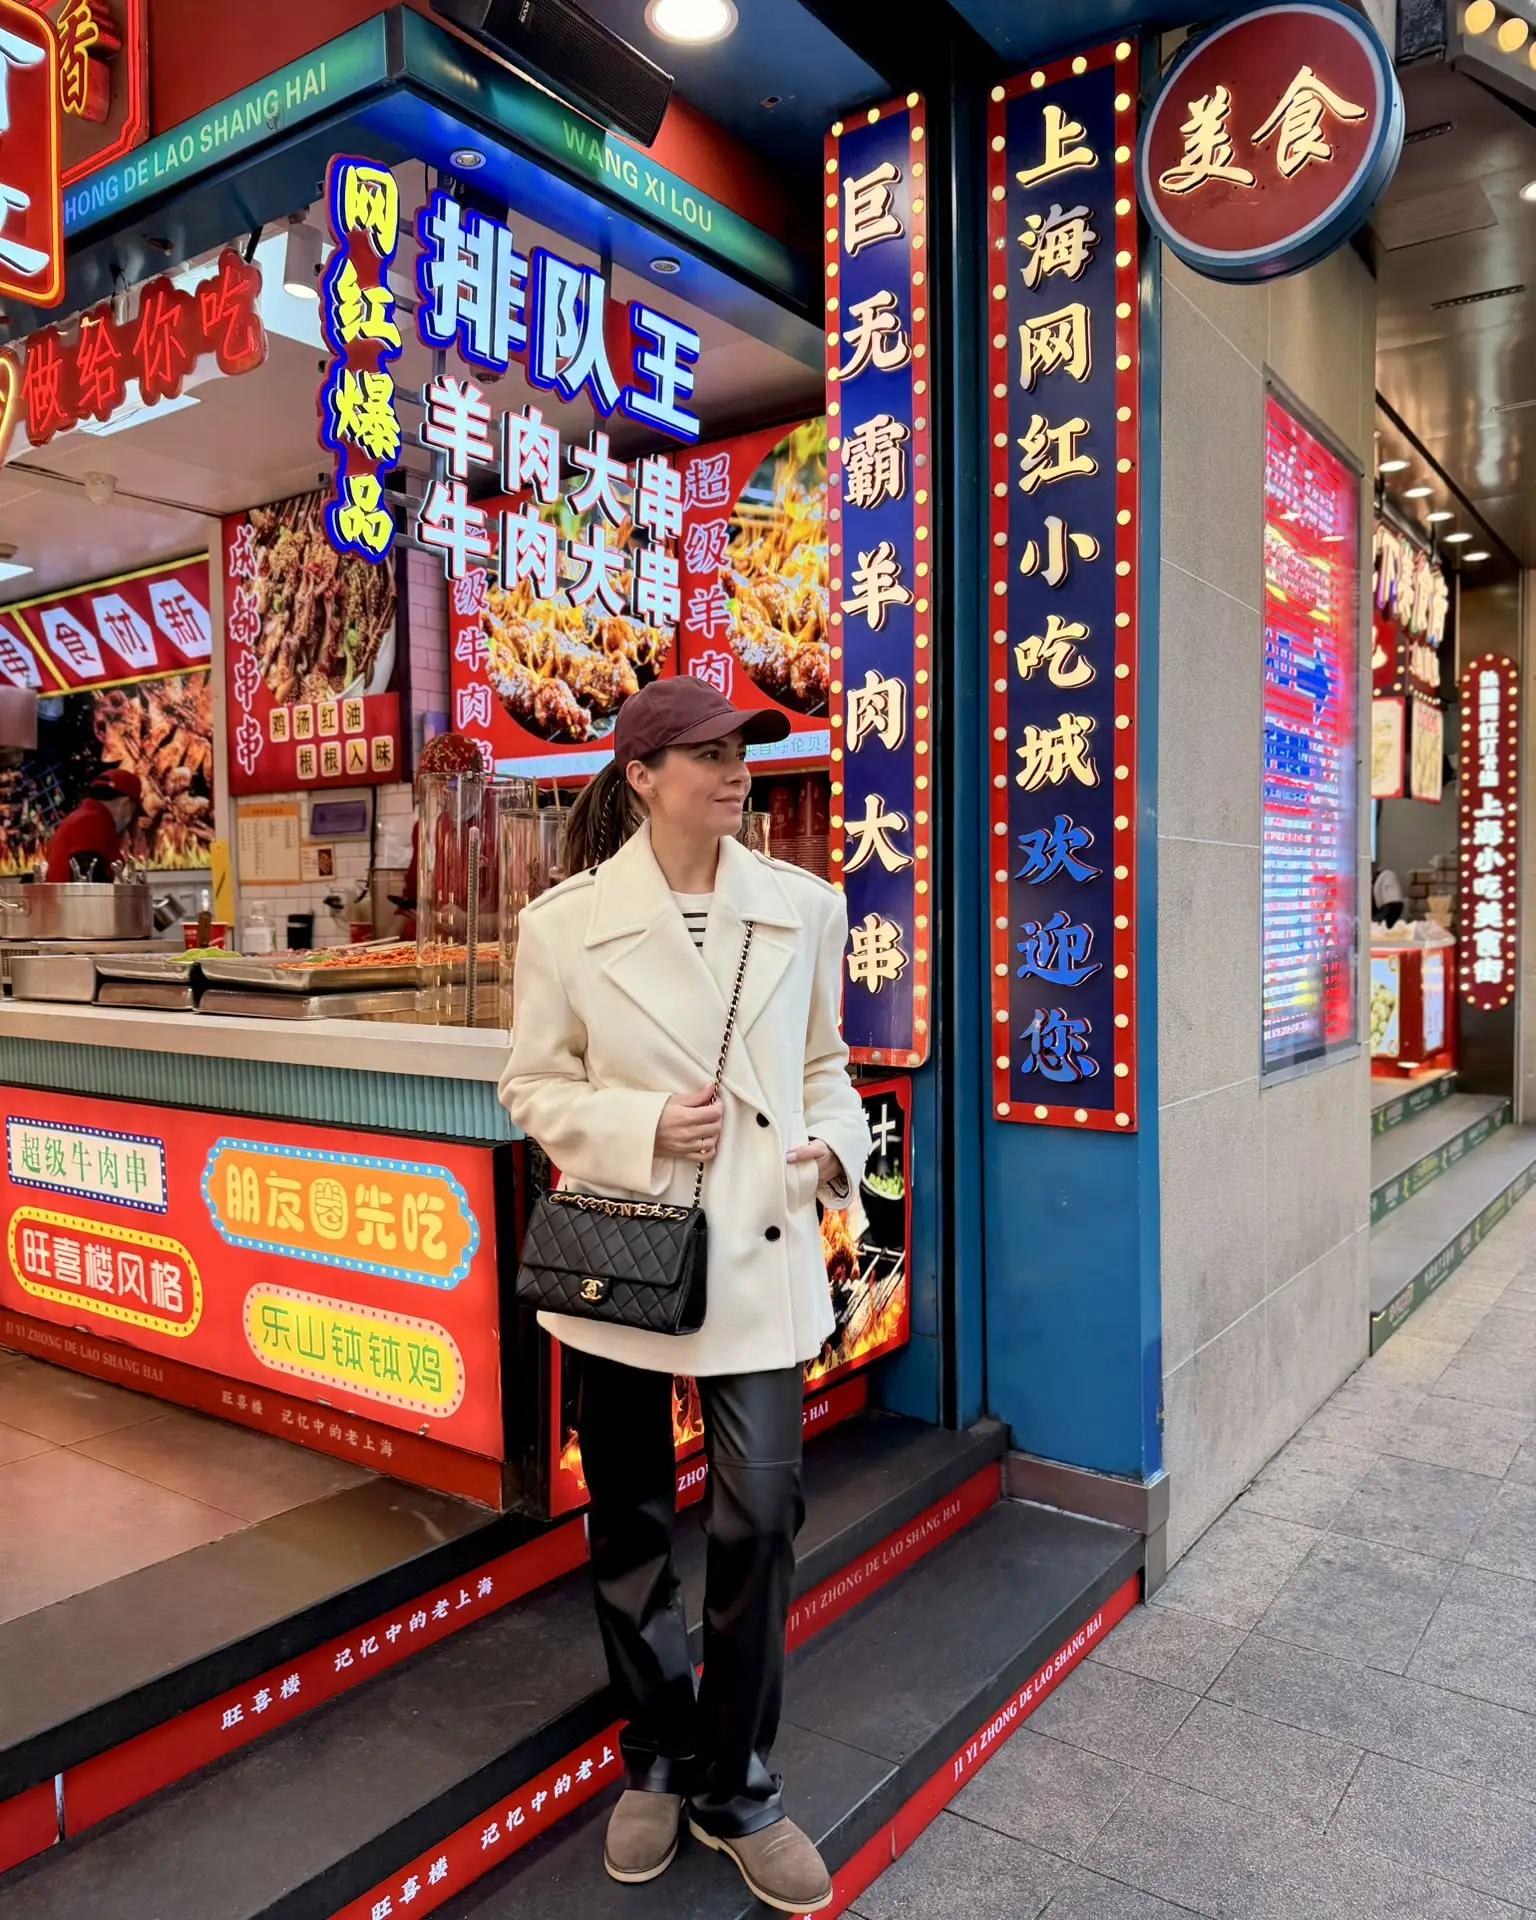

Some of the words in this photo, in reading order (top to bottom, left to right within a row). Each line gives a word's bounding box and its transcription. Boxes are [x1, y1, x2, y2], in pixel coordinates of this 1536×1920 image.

[63, 175, 118, 225] HONG
[124, 158, 149, 193] DE
[154, 135, 194, 178] LAO
[200, 90, 279, 153] SHANG
[285, 62, 326, 110] HAI
[563, 120, 639, 189] WANG
[643, 171, 665, 206] XI
[671, 187, 712, 233] LOU
[1159, 65, 1367, 194] 美食
[21, 265, 253, 434] 做给你吃
[333, 165, 401, 553] 网红爆品
[426, 196, 700, 438] 排队王
[420, 375, 683, 543] 羊肉大串
[417, 480, 682, 627] 牛肉大串
[838, 162, 912, 992] 巨无霸羊肉大串
[1014, 104, 1102, 1082] 上海网红小吃城欢迎您
[229, 524, 263, 776] 成都串串
[272, 702, 362, 740] 鸡汤红油
[300, 742, 391, 774] 根根入味
[746, 734, 830, 757] 来自呼伦贝
[20, 1133, 149, 1194] 超级牛肉串
[226, 1163, 448, 1260] 朋友圈先吃
[23, 1227, 184, 1314] 旺喜楼风格
[16, 1324, 26, 1337] YI
[28, 1328, 63, 1349] ZHONG
[64, 1339, 78, 1355] DE
[80, 1345, 100, 1361] LAO
[102, 1352, 140, 1375] SHANG
[143, 1365, 164, 1382] HAI
[260, 1304, 443, 1394] 乐山钵钵鸡
[810, 1400, 829, 1421] HAI
[222, 1390, 264, 1416] 旺喜楼
[281, 1409, 394, 1458] 记忆中的老上海
[790, 1612, 800, 1632] JI
[804, 1600, 817, 1619] YI
[820, 1570, 862, 1609] ZHONG
[865, 1556, 880, 1577] DE
[882, 1540, 904, 1564] LAO
[906, 1514, 941, 1548] SHANG
[943, 1500, 961, 1522] HAI
[220, 1672, 301, 1730] 旺喜楼
[334, 1576, 494, 1672] 记忆中的老上海
[953, 1761, 964, 1782] JI
[965, 1741, 978, 1762] YI
[980, 1702, 1018, 1750] ZHONG
[1019, 1684, 1033, 1709] DE
[1034, 1665, 1053, 1693] LAO
[1055, 1636, 1086, 1671] SHANG
[1086, 1613, 1103, 1640] HAI
[370, 1855, 449, 1920] 旺喜楼
[479, 1746, 616, 1850] 记忆中的老上
